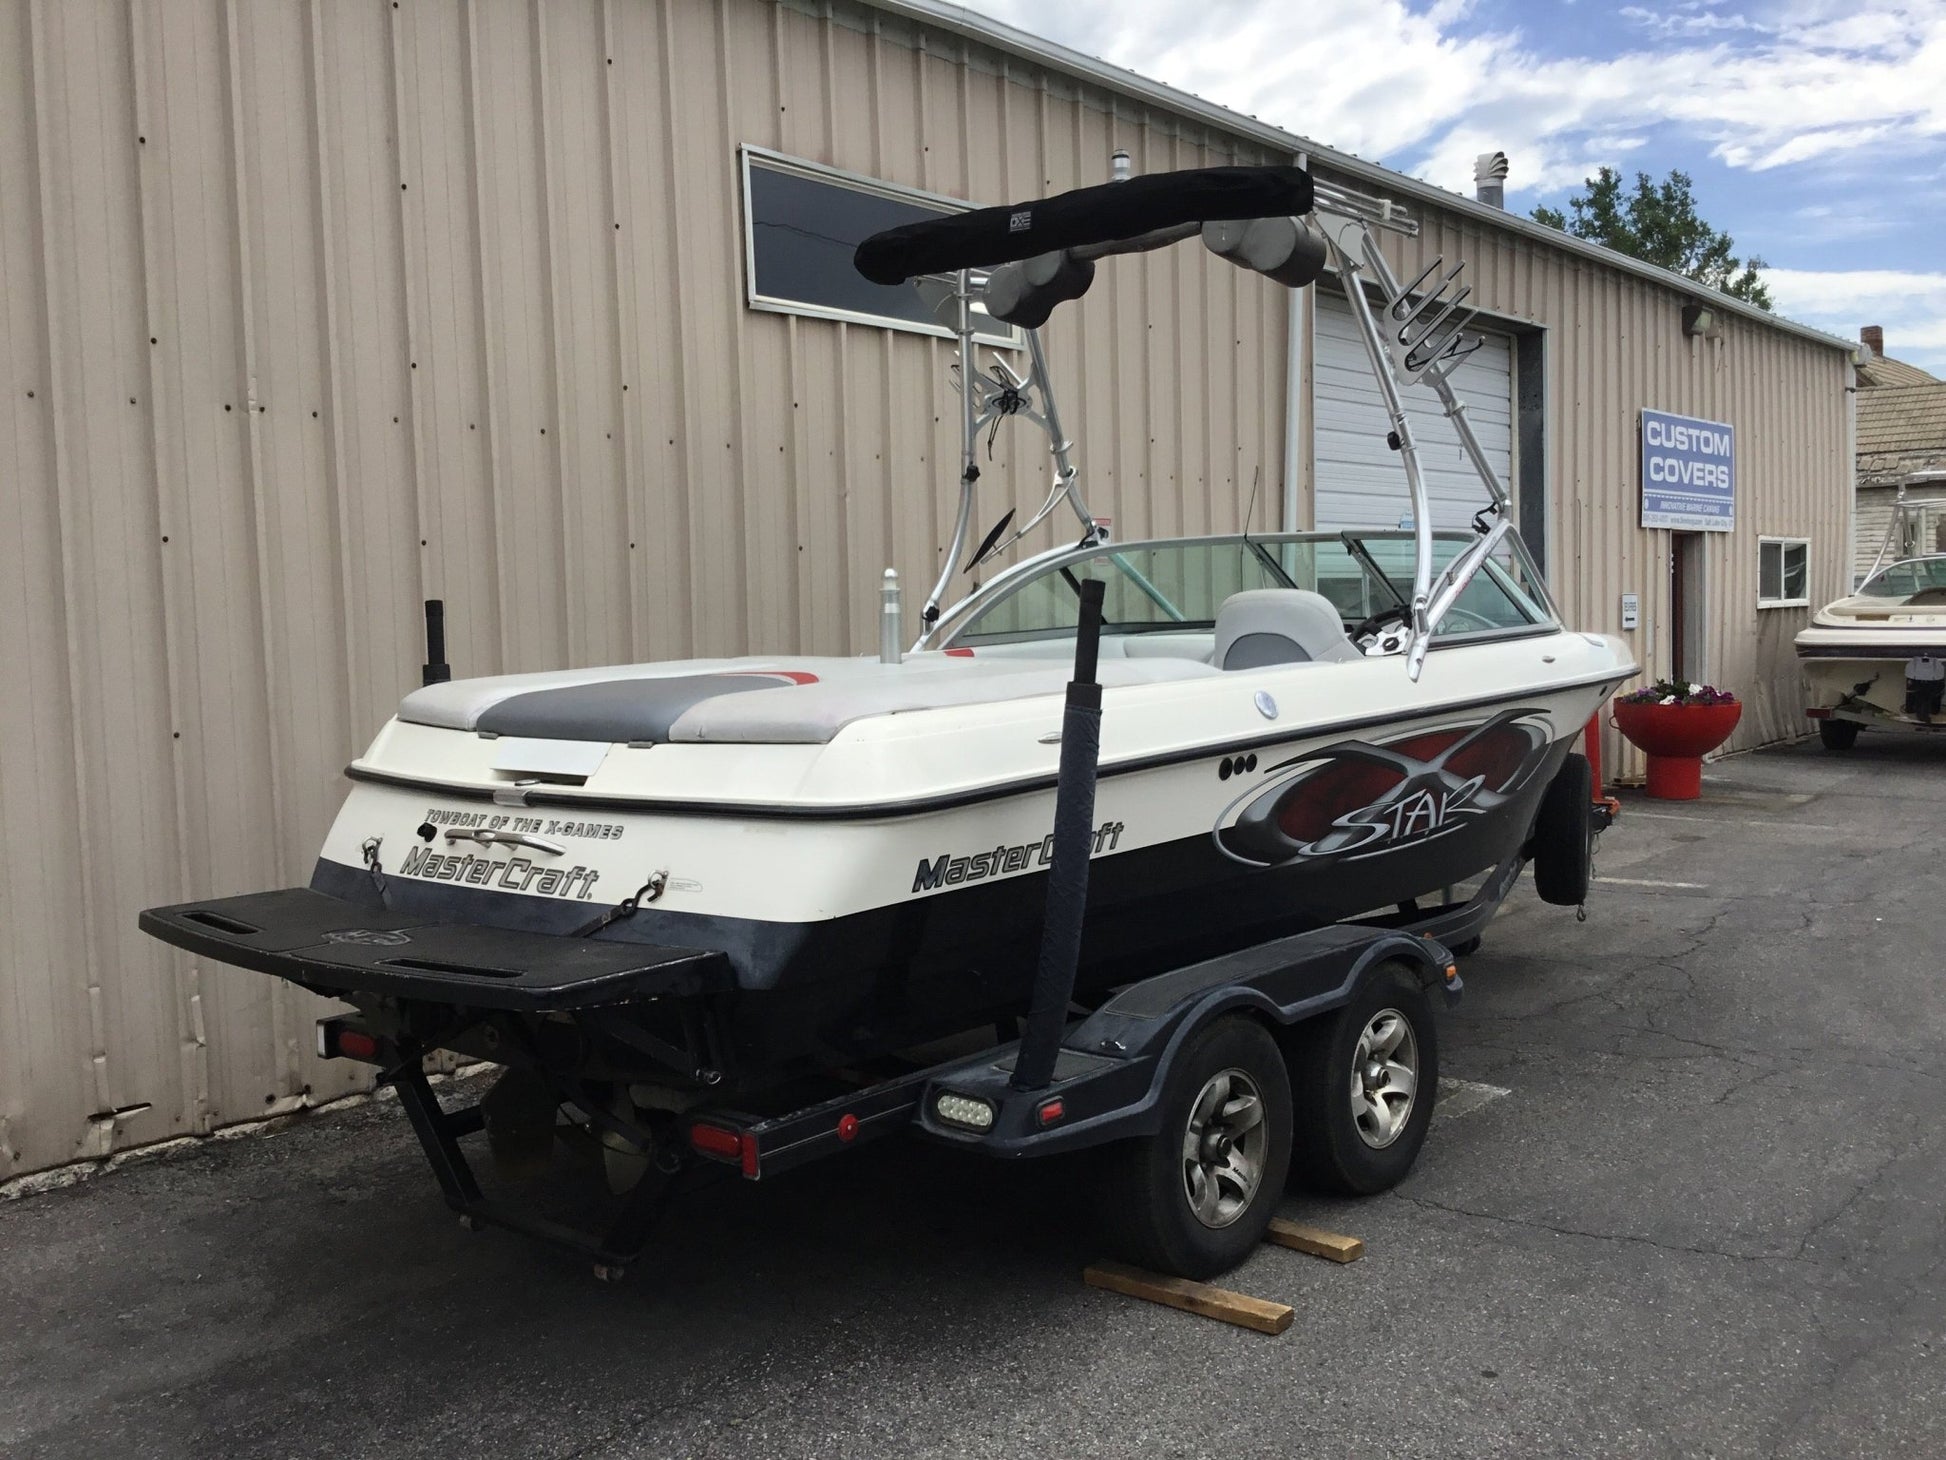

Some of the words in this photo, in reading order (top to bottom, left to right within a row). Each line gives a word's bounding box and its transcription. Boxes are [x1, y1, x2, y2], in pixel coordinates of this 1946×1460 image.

[1646, 421, 1730, 457] CUSTOM
[1649, 456, 1729, 488] COVERS
[425, 809, 487, 828] TOWBOAT
[489, 815, 509, 829] OF
[513, 817, 543, 833] THE
[545, 820, 625, 840] X-GAMES
[1298, 775, 1488, 856] STAR
[400, 846, 600, 900] MasterCraft
